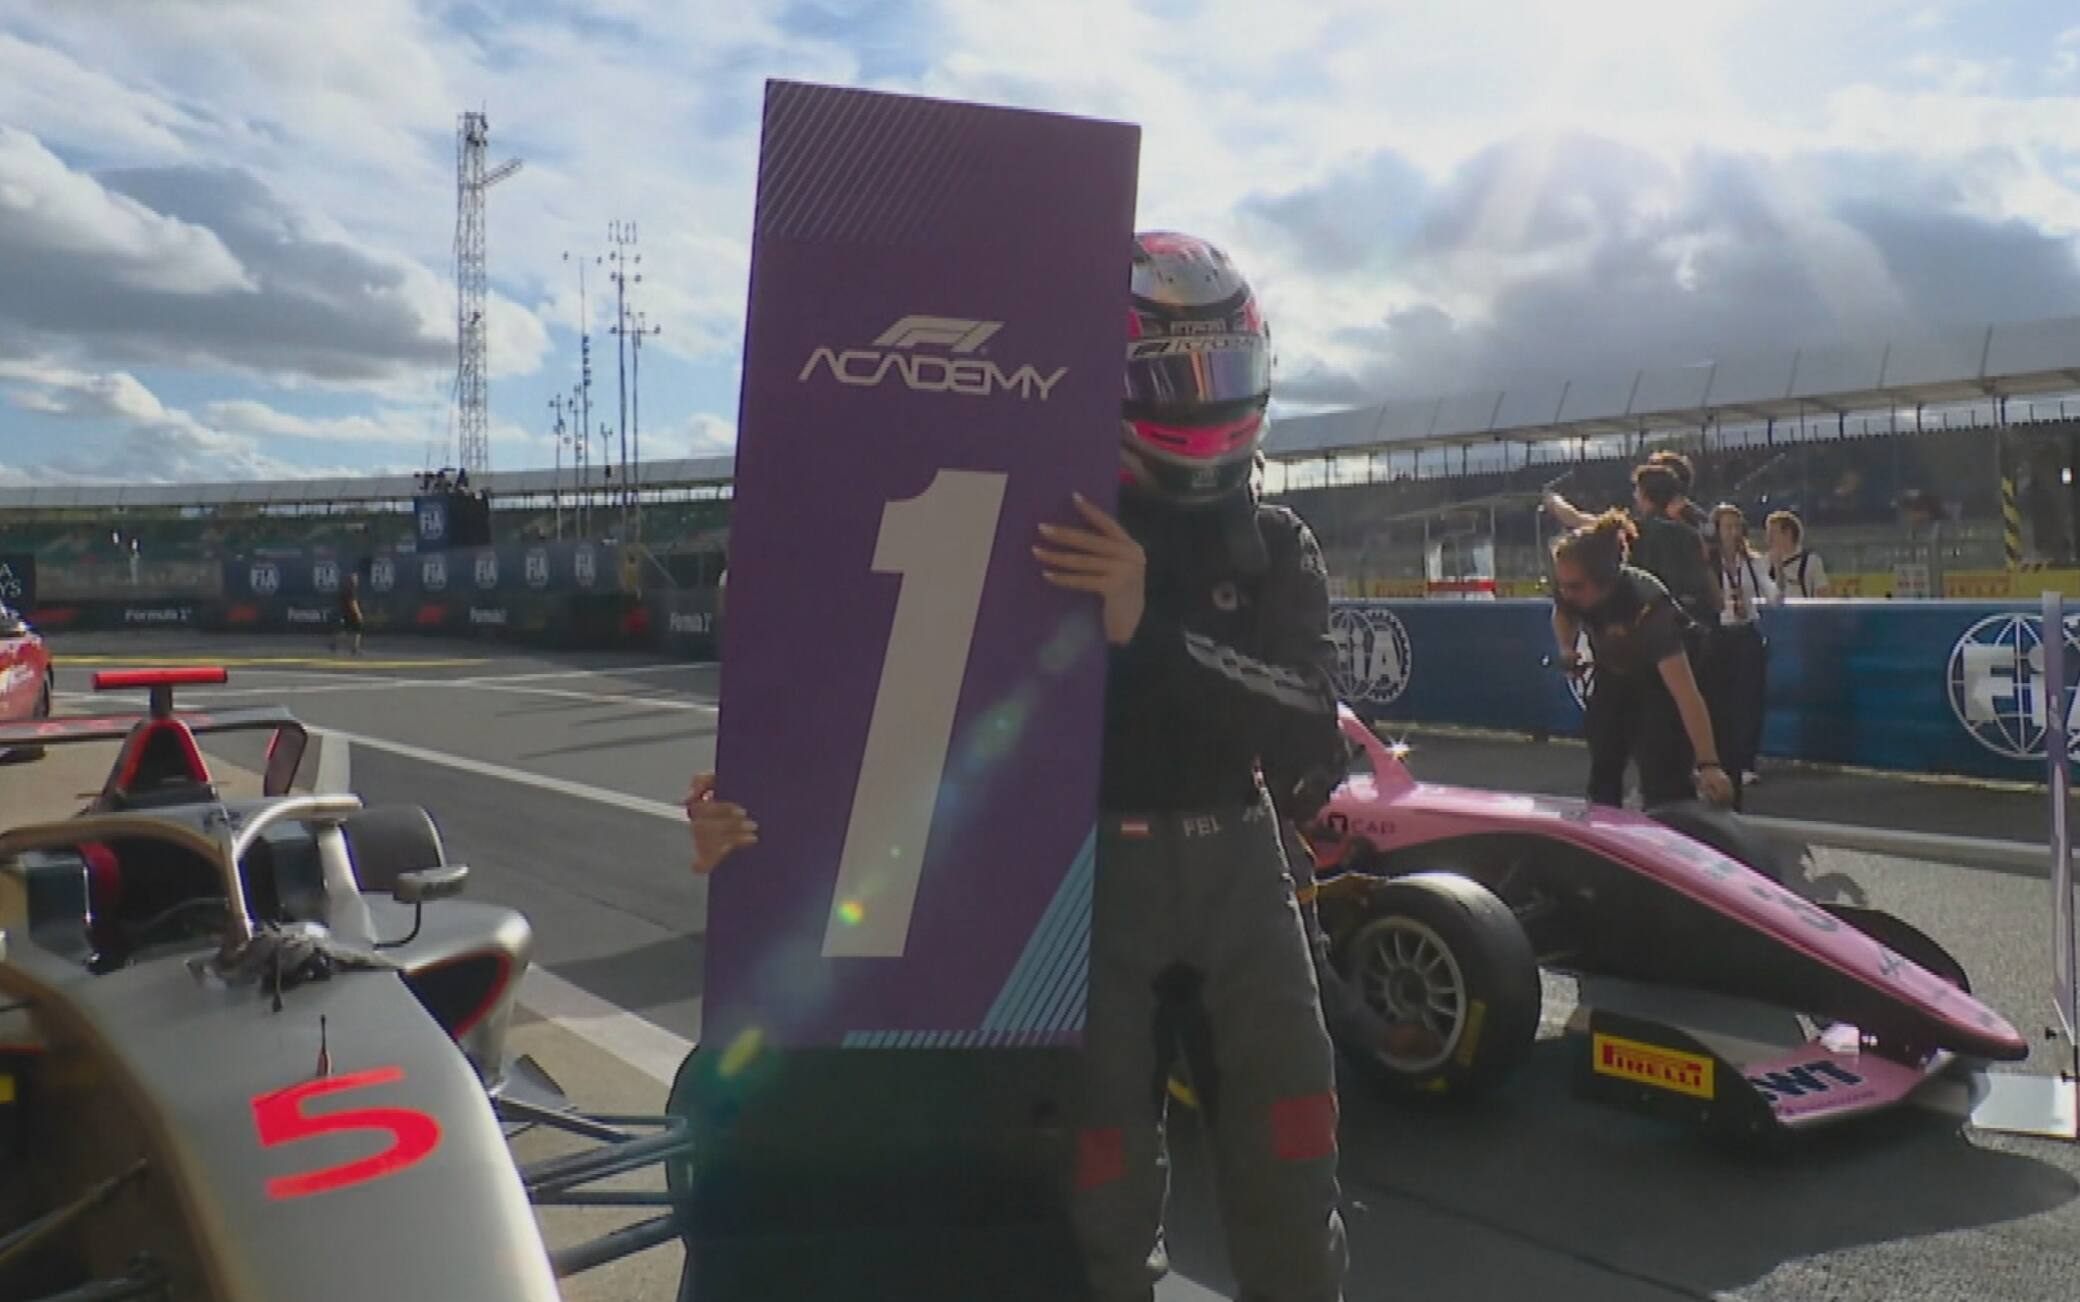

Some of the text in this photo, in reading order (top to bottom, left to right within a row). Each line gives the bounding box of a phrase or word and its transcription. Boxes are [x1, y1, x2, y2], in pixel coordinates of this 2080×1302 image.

[798, 347, 1070, 401] ACADEMY
[821, 469, 1009, 957] 1
[1602, 1042, 1703, 1089] PIRELLI
[249, 1065, 442, 1199] 5
